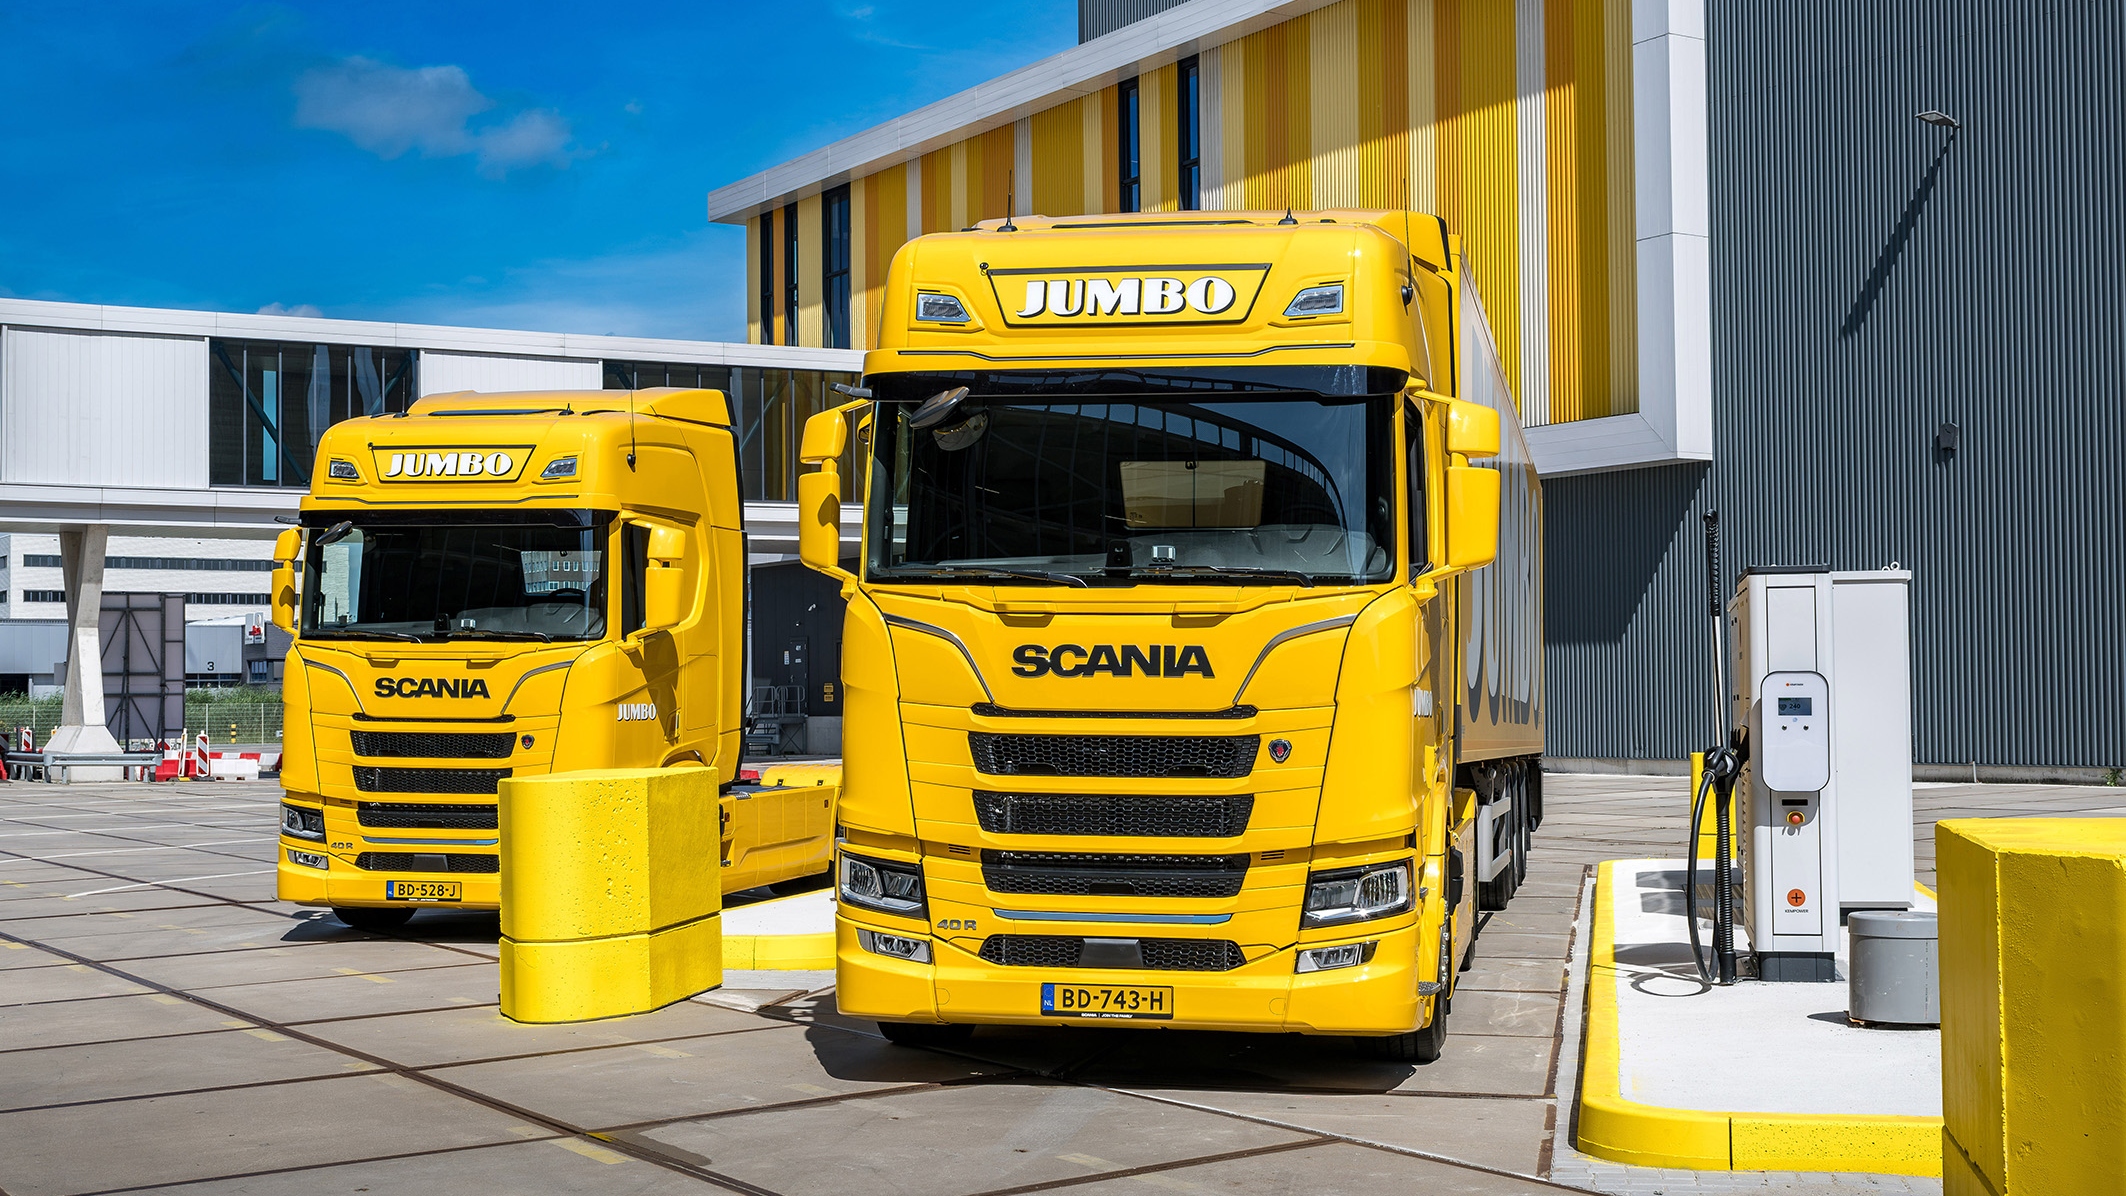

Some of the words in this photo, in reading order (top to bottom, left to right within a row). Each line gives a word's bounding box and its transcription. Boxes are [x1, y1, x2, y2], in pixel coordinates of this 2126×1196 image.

[1016, 276, 1236, 318] JUMBO
[385, 452, 513, 477] JUMBO
[1466, 324, 1541, 730] JUMBO
[207, 661, 215, 671] 3
[1011, 644, 1215, 678] SCANIA
[374, 677, 491, 699] SCANIA
[617, 703, 657, 721] JUMBO
[398, 884, 456, 897] BD-528-J
[937, 919, 961, 930] 40
[964, 920, 976, 930] R
[1062, 989, 1163, 1010] BD-743-H
